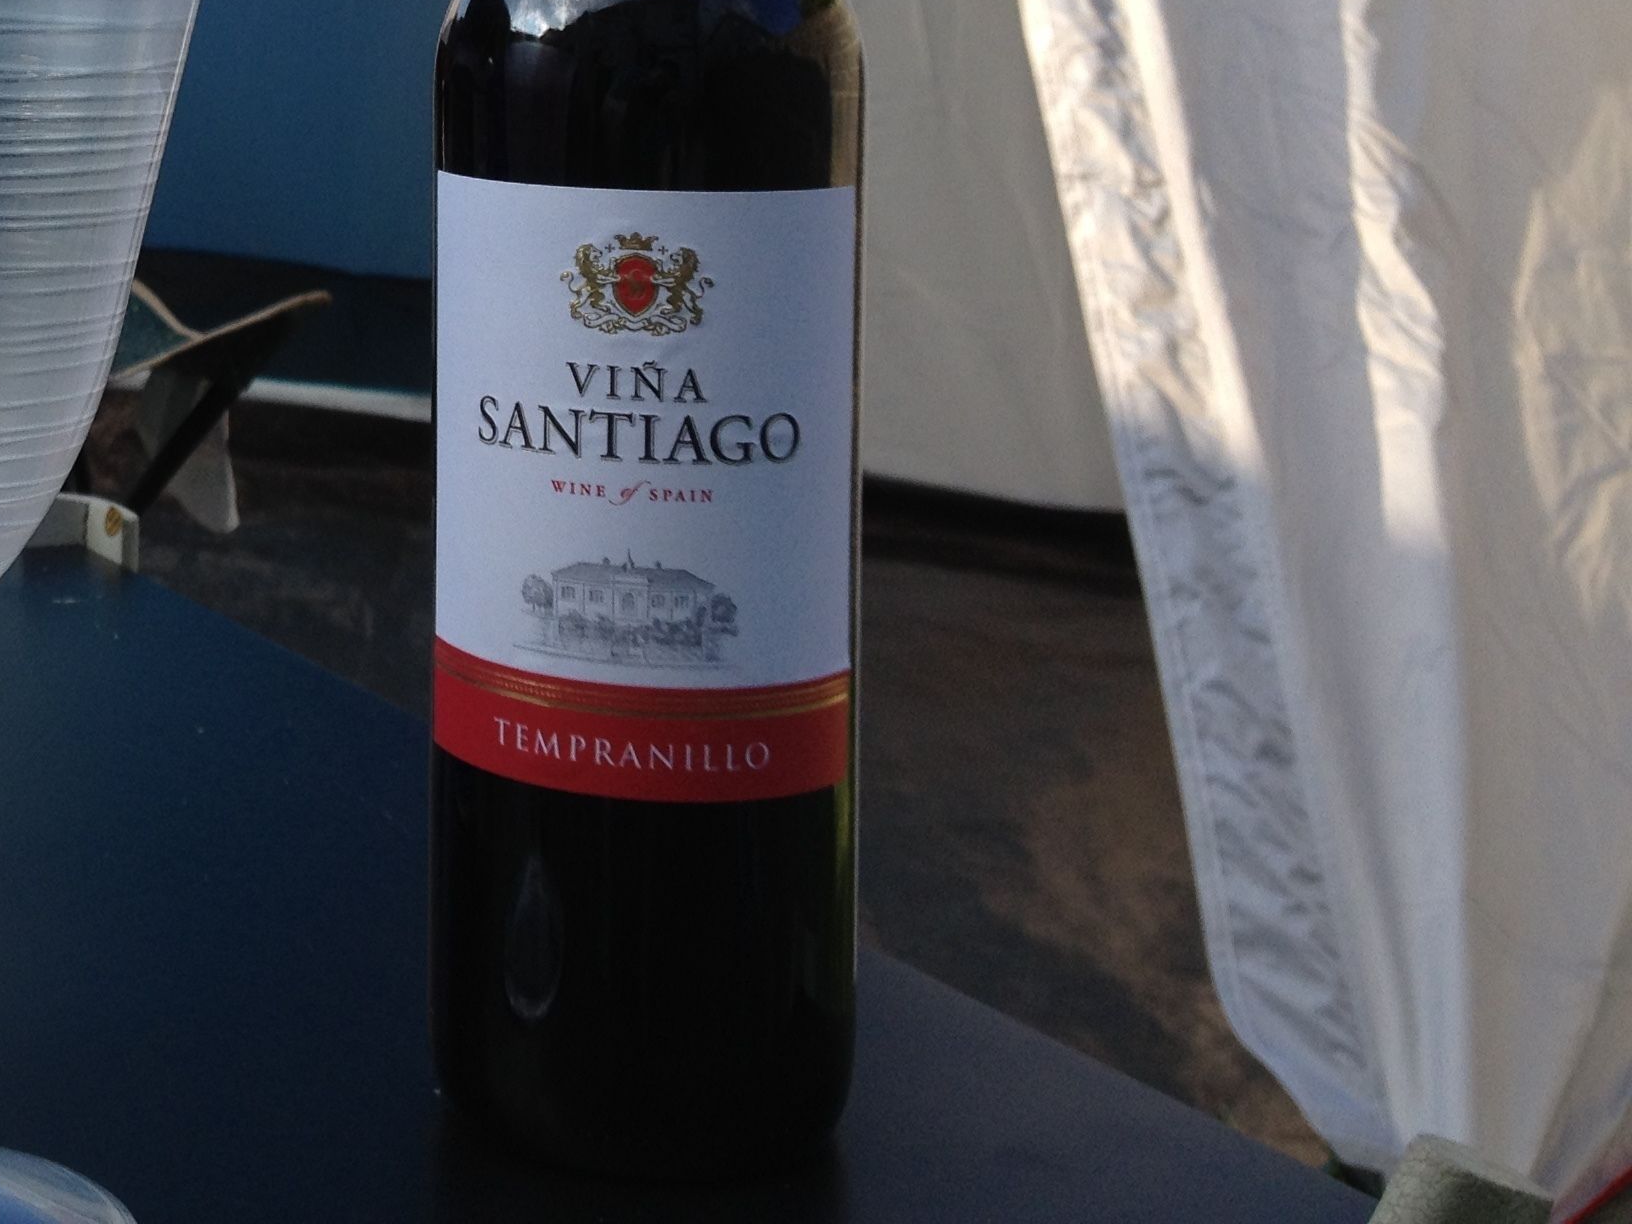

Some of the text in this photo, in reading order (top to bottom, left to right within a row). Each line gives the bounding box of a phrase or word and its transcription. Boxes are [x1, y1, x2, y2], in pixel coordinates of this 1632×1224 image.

[566, 360, 709, 404] VIÑA
[478, 396, 802, 466] SANTIAGO
[551, 479, 715, 507] WINE of SPAIN
[494, 717, 770, 773] TEMPRANILLO
